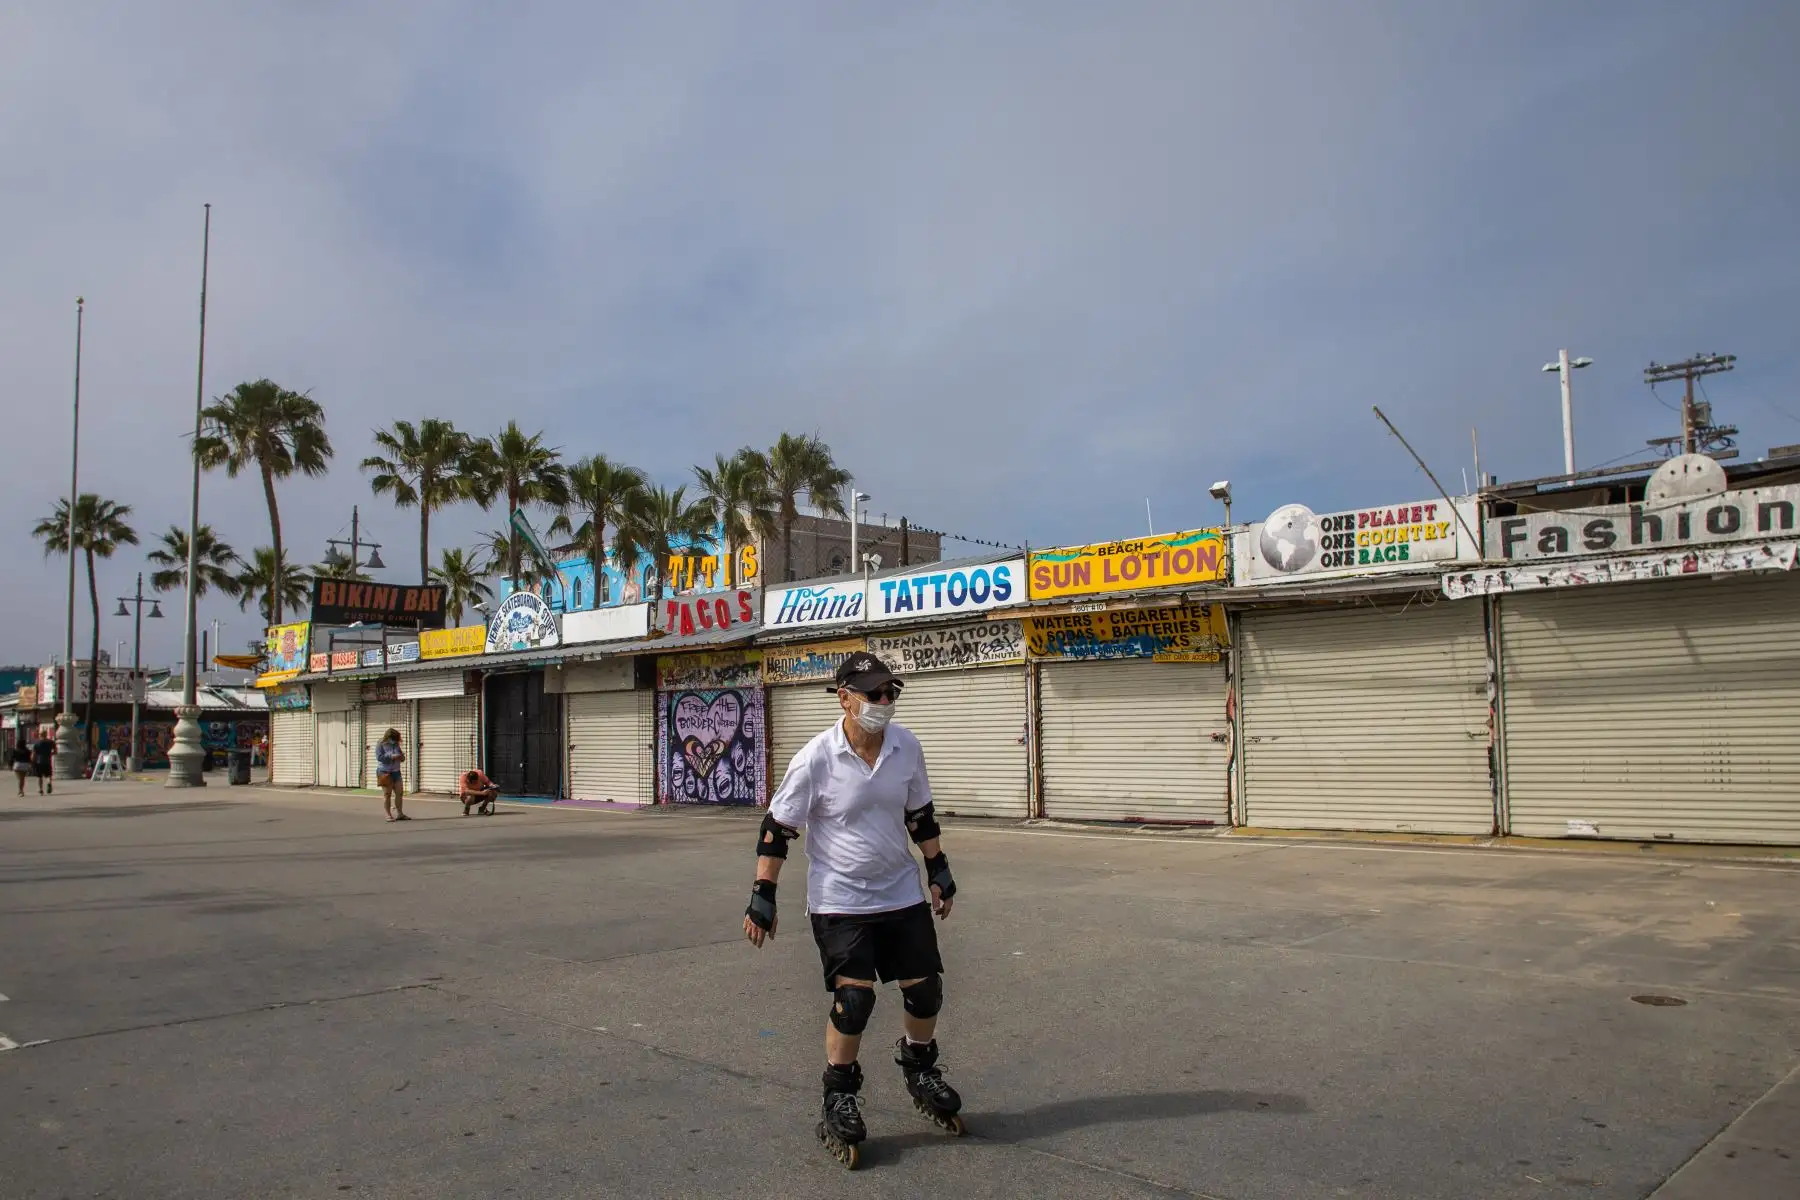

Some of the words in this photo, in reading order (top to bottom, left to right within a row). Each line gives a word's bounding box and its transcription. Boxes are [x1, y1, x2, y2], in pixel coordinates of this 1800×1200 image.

[1320, 514, 1355, 532] ONE
[1357, 503, 1437, 529] PLANET
[1501, 500, 1794, 559] Fashion
[1320, 531, 1355, 550] ONE
[1356, 521, 1450, 548] COUNTRY
[1098, 542, 1144, 557] BEACH
[1320, 549, 1355, 568] ONE
[1358, 544, 1409, 564] RACE
[668, 545, 759, 589] TITIS
[1034, 561, 1091, 591] SUN
[1103, 545, 1217, 583] LOTION
[320, 581, 399, 611] BIKINI
[404, 588, 442, 612] BAY
[880, 565, 1012, 614] TATTOOS
[666, 591, 753, 636] TACOS
[773, 586, 864, 625] Henna
[1032, 613, 1092, 629] WATERS
[1110, 605, 1212, 624] CIGARETTES
[488, 612, 504, 645] VENICE
[502, 594, 541, 618] SKATEBOARDING
[541, 608, 556, 636] STUFF
[1047, 627, 1094, 645] SODAS
[1111, 620, 1200, 638] BATTERIES
[880, 634, 934, 650] HENNA
[936, 623, 1010, 644] TATTOOS
[902, 647, 944, 662] BODY
[951, 640, 981, 658] ART
[983, 650, 1021, 660] MINUTES
[81, 681, 133, 691] Sewalk
[81, 690, 123, 700] Mrket
[681, 700, 709, 715] FREE
[677, 715, 715, 732] BORDER
